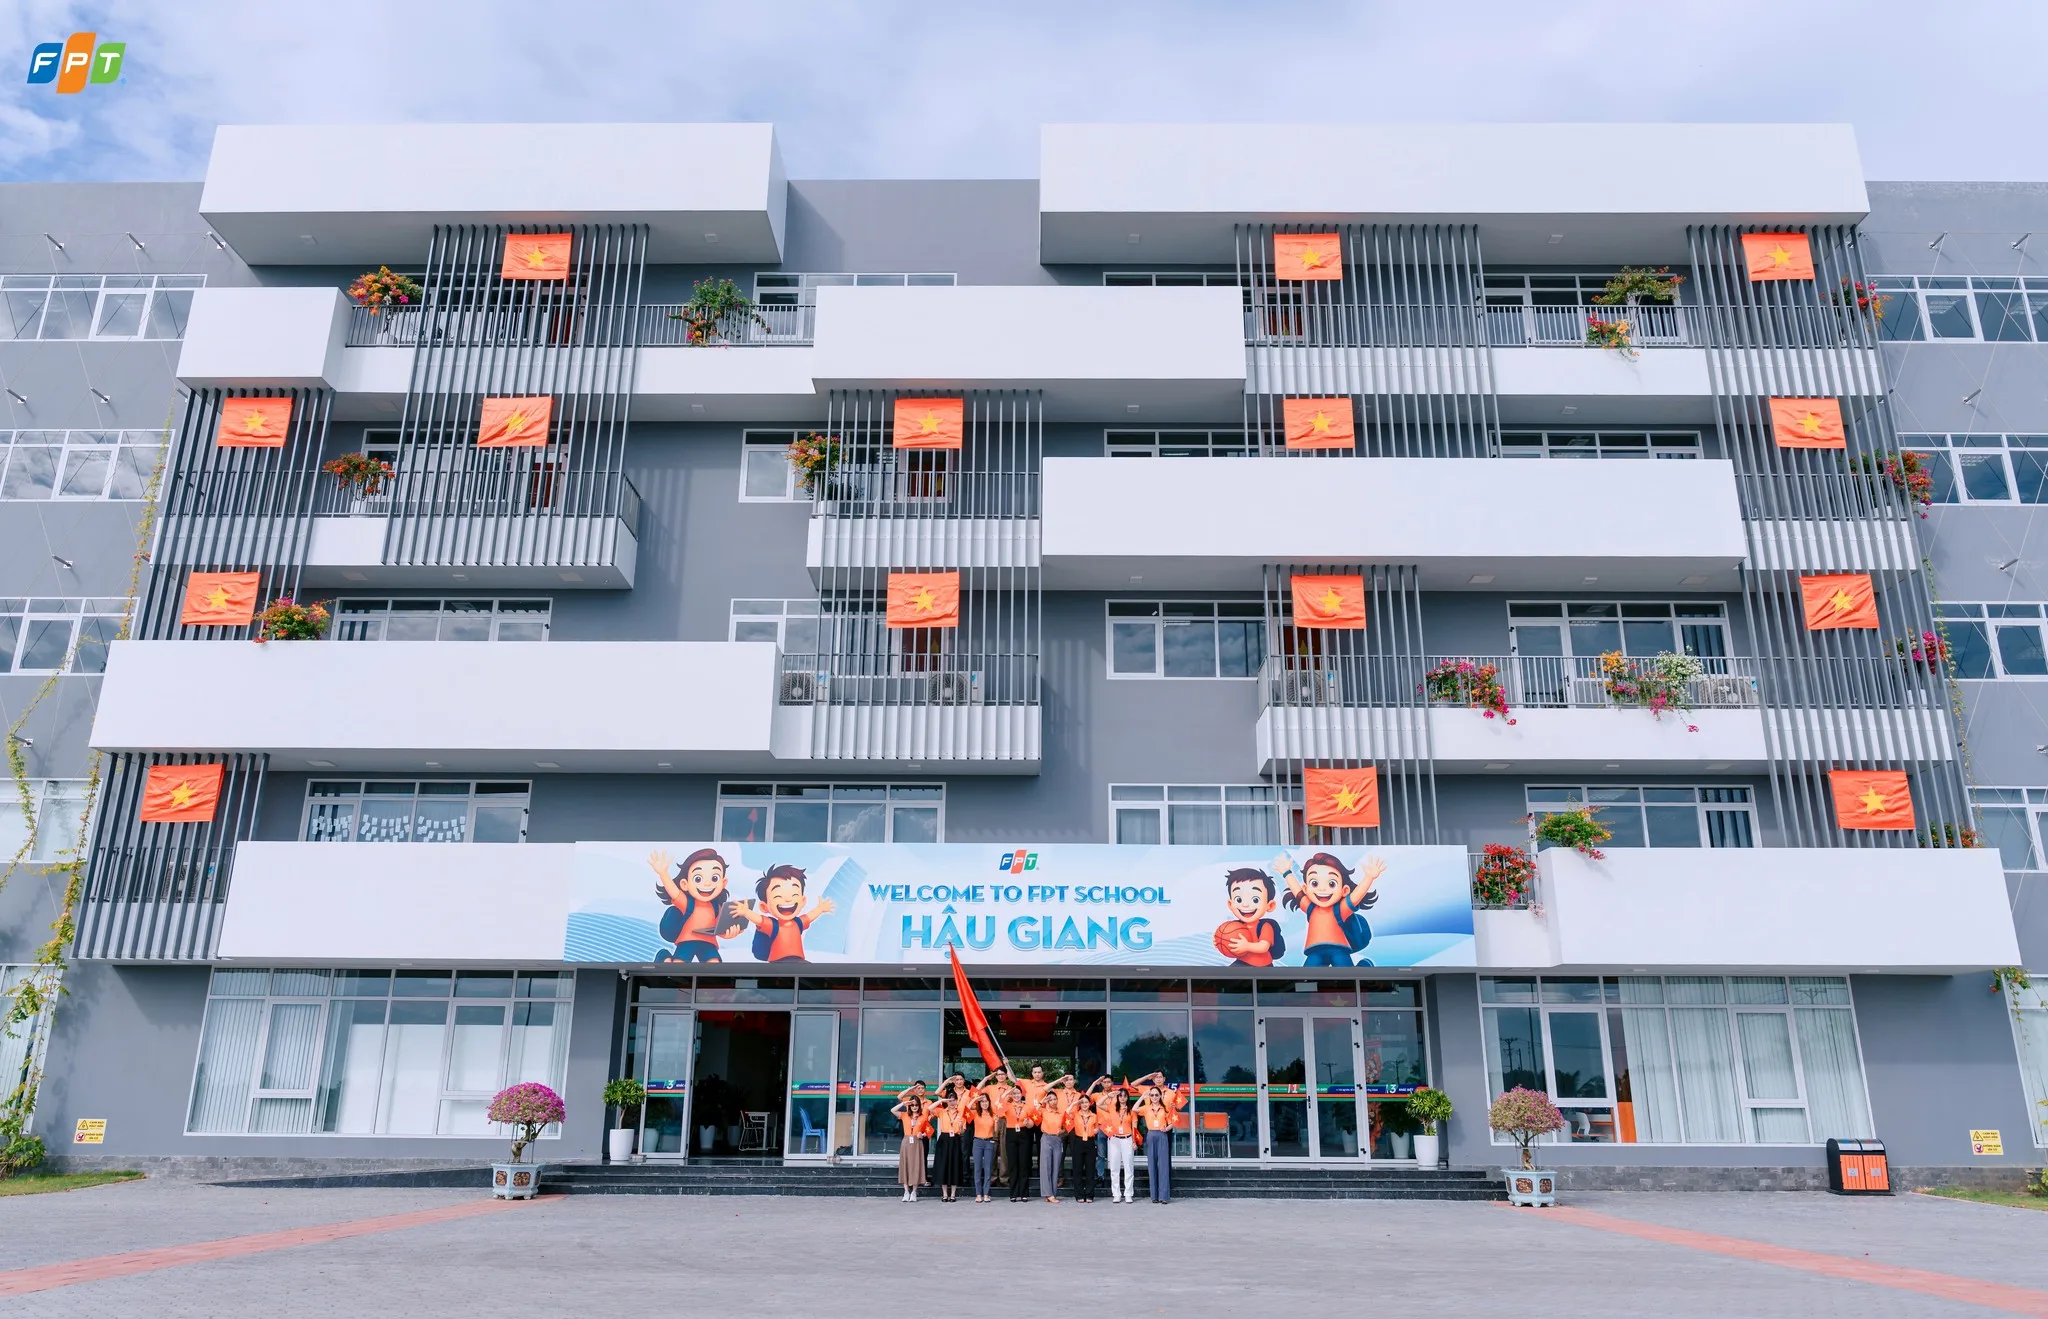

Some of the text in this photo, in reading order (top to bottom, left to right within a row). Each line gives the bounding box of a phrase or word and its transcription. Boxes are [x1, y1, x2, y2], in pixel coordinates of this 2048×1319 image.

[868, 884, 1172, 904] WELCOME TO FPT SCHOOL
[901, 903, 1153, 960] HẬU GIANG
[1390, 1084, 1397, 1094] 3
